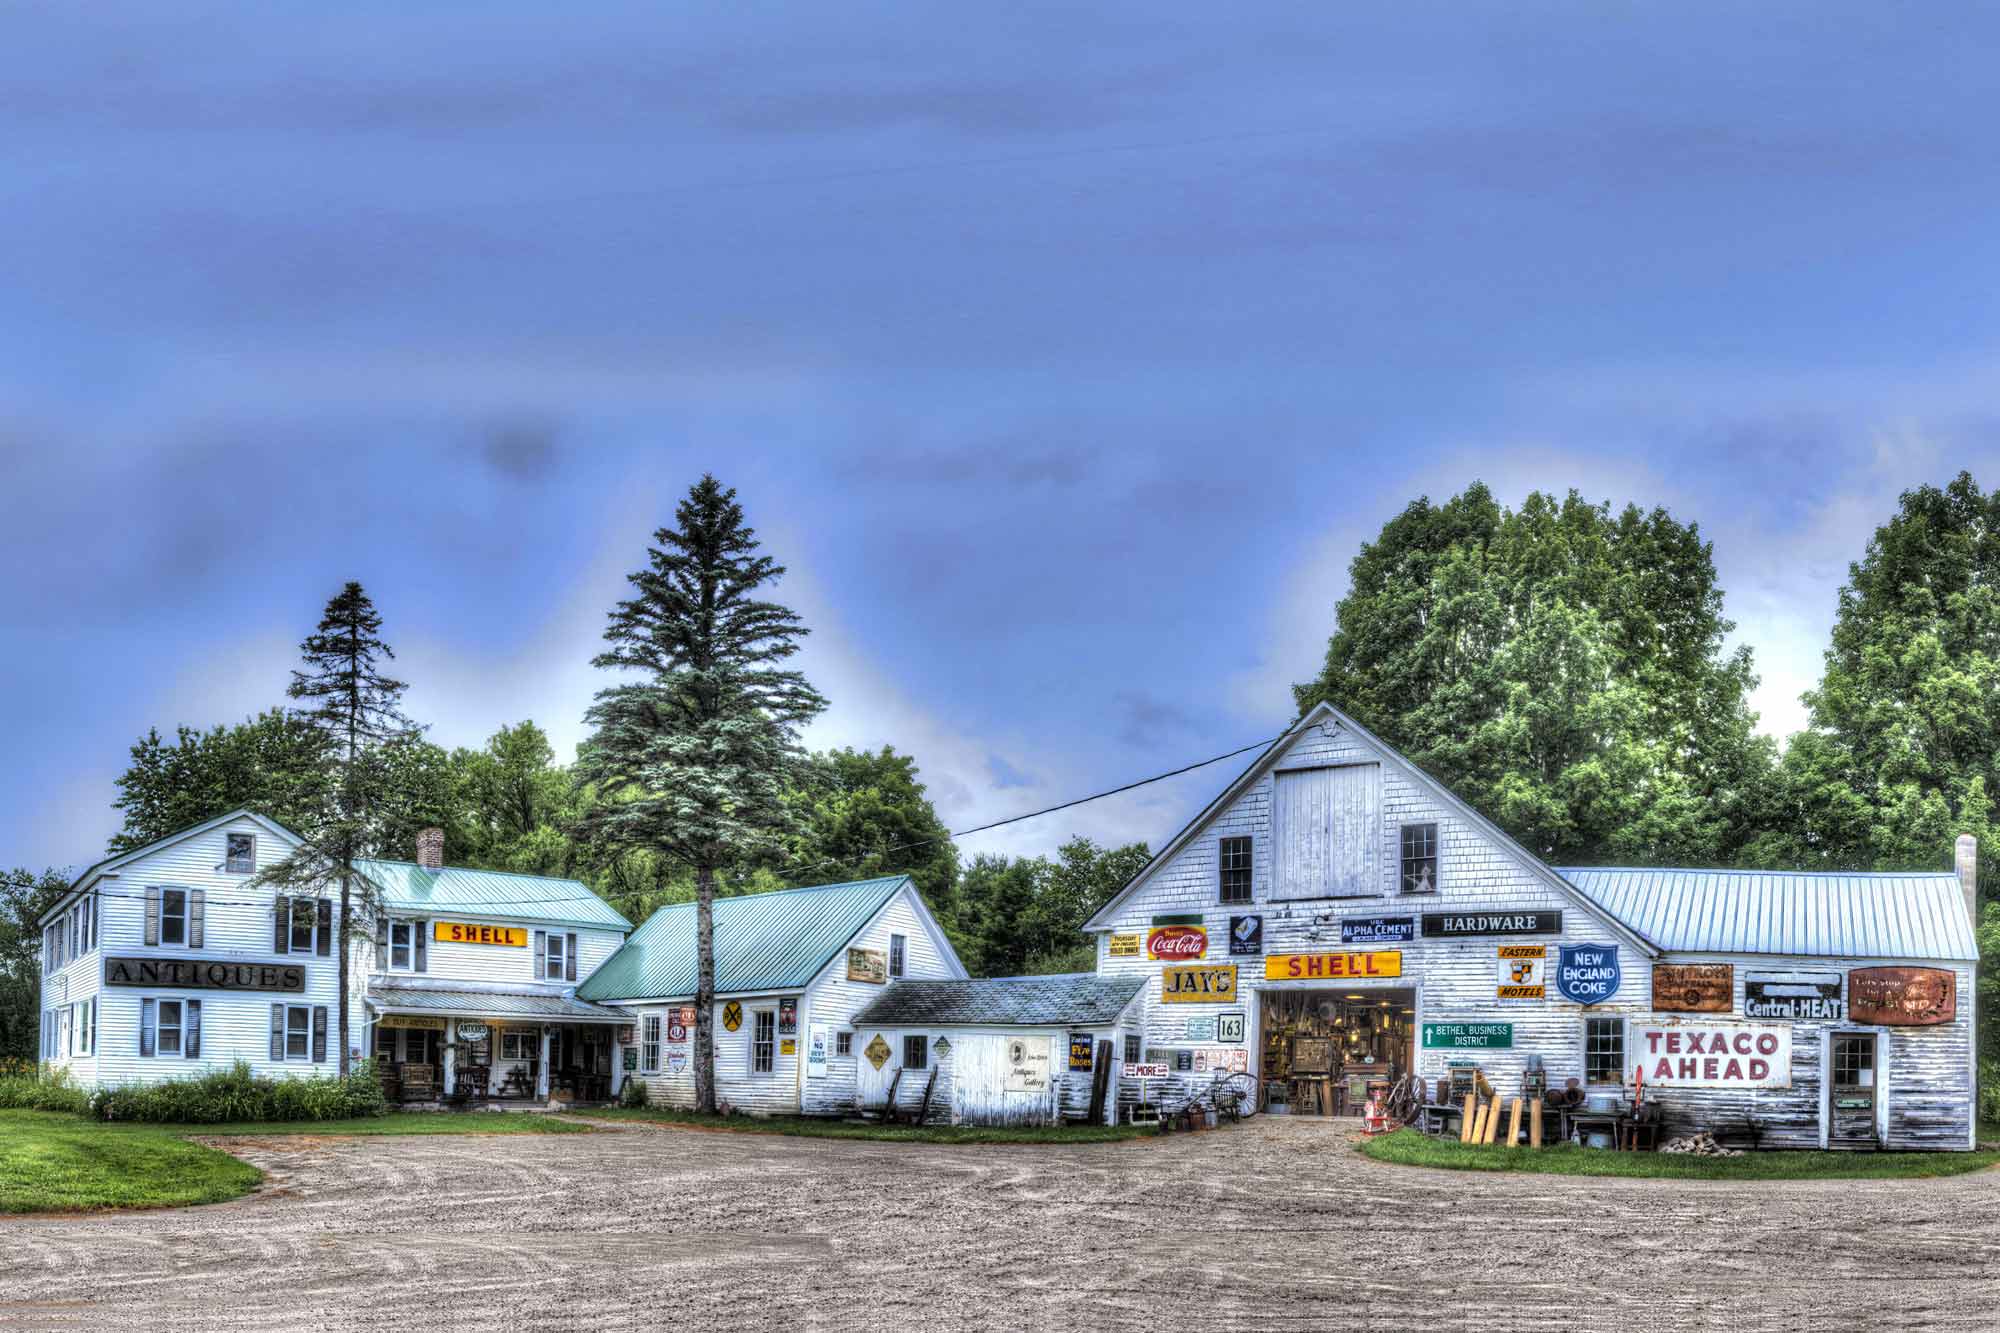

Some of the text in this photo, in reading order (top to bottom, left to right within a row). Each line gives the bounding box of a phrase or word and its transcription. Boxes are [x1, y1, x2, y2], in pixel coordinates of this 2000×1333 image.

[1342, 923, 1413, 937] ALPHA CEMENT
[1443, 916, 1537, 931] HARDWARE
[452, 925, 514, 944] SHELL
[1151, 934, 1202, 954] Coca-Cola
[1502, 947, 1544, 957] EASTERN
[1574, 952, 1603, 966] NEW
[1288, 954, 1380, 977] SHELL
[112, 962, 301, 988] ANTIQUES
[1563, 967, 1616, 980] ENGLAND
[1167, 970, 1231, 993] JAY'S
[1569, 981, 1607, 994] COKE
[1500, 987, 1542, 997] MOTELS
[1221, 1020, 1241, 1036] 163
[1436, 1025, 1508, 1035] BETHEL BUSINESS
[814, 1042, 824, 1050] NO
[1454, 1036, 1488, 1046] DISTRICT
[1645, 1031, 1779, 1055] TEXACO
[1136, 1065, 1157, 1077] MORE
[1653, 1057, 1770, 1080] AHEAD
